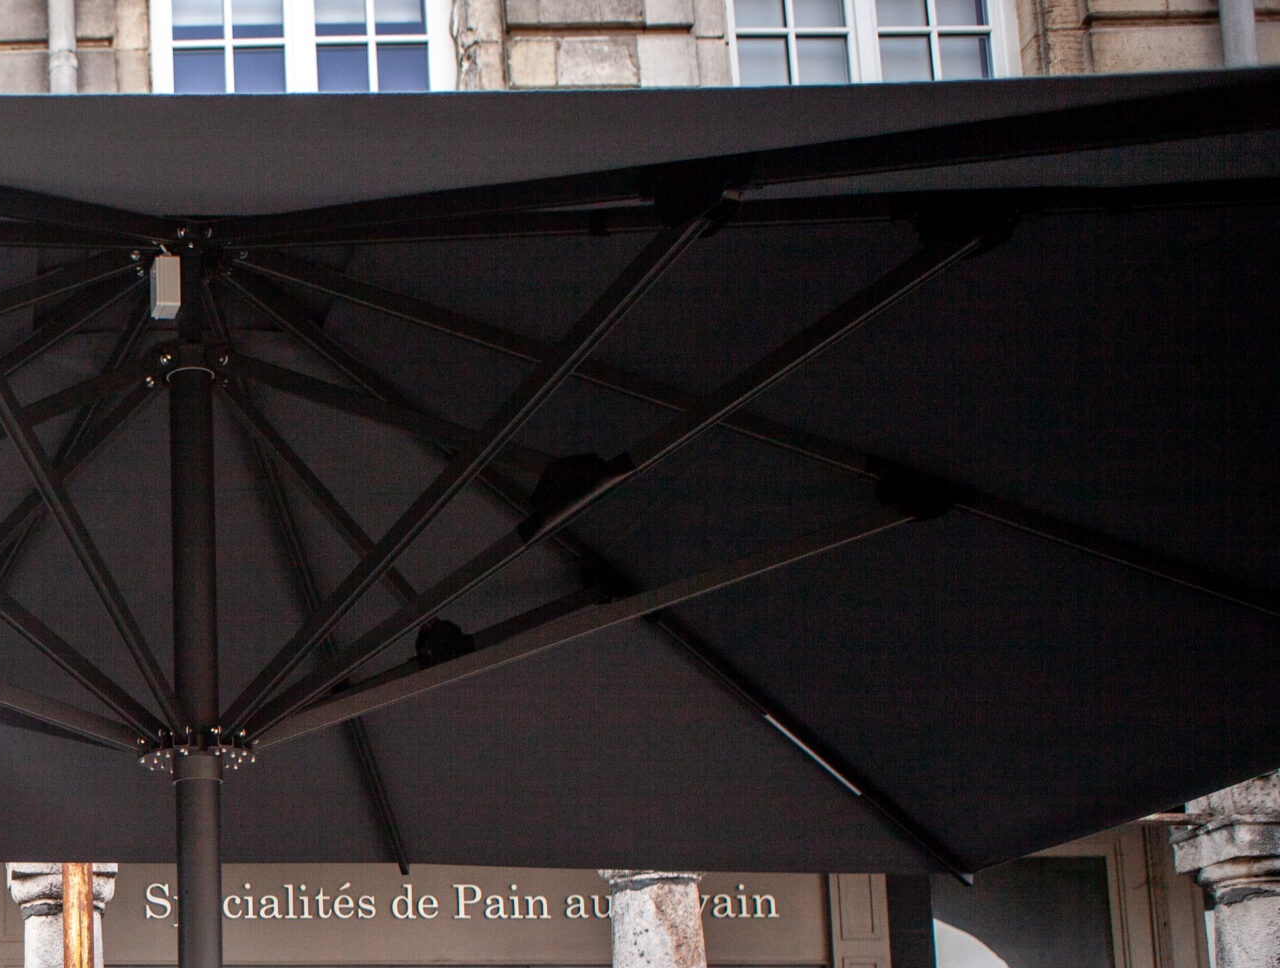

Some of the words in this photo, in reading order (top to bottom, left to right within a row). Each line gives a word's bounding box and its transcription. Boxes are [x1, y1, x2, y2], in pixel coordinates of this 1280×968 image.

[145, 882, 376, 925] Scialités
[393, 883, 439, 919] de
[453, 883, 551, 919] Pain
[566, 891, 613, 920] au
